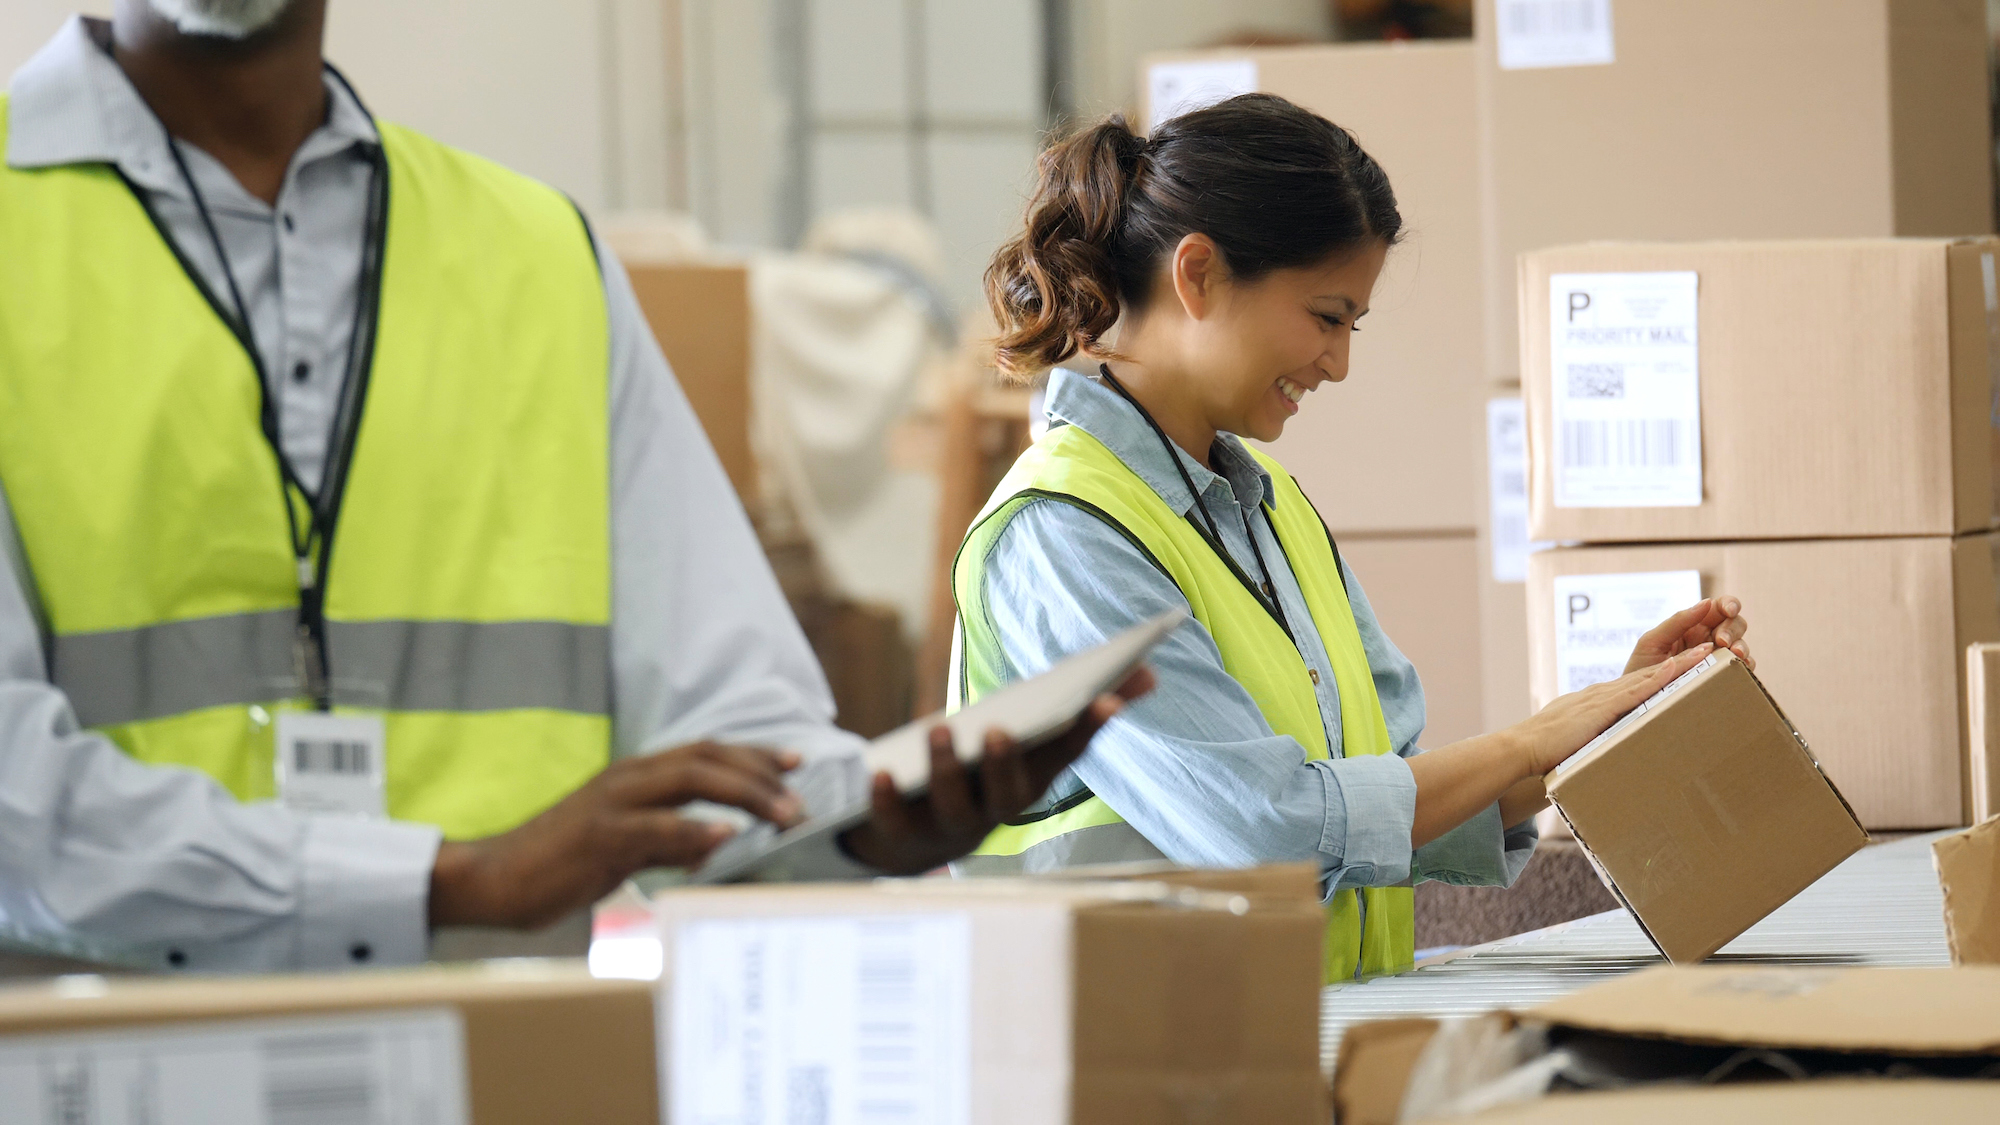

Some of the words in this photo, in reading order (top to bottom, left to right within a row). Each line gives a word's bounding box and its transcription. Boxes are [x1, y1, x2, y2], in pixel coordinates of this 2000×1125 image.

[1568, 292, 1591, 323] P
[1567, 327, 1642, 346] PRIORITY
[1649, 327, 1689, 345] MAIL
[1568, 594, 1591, 624] P
